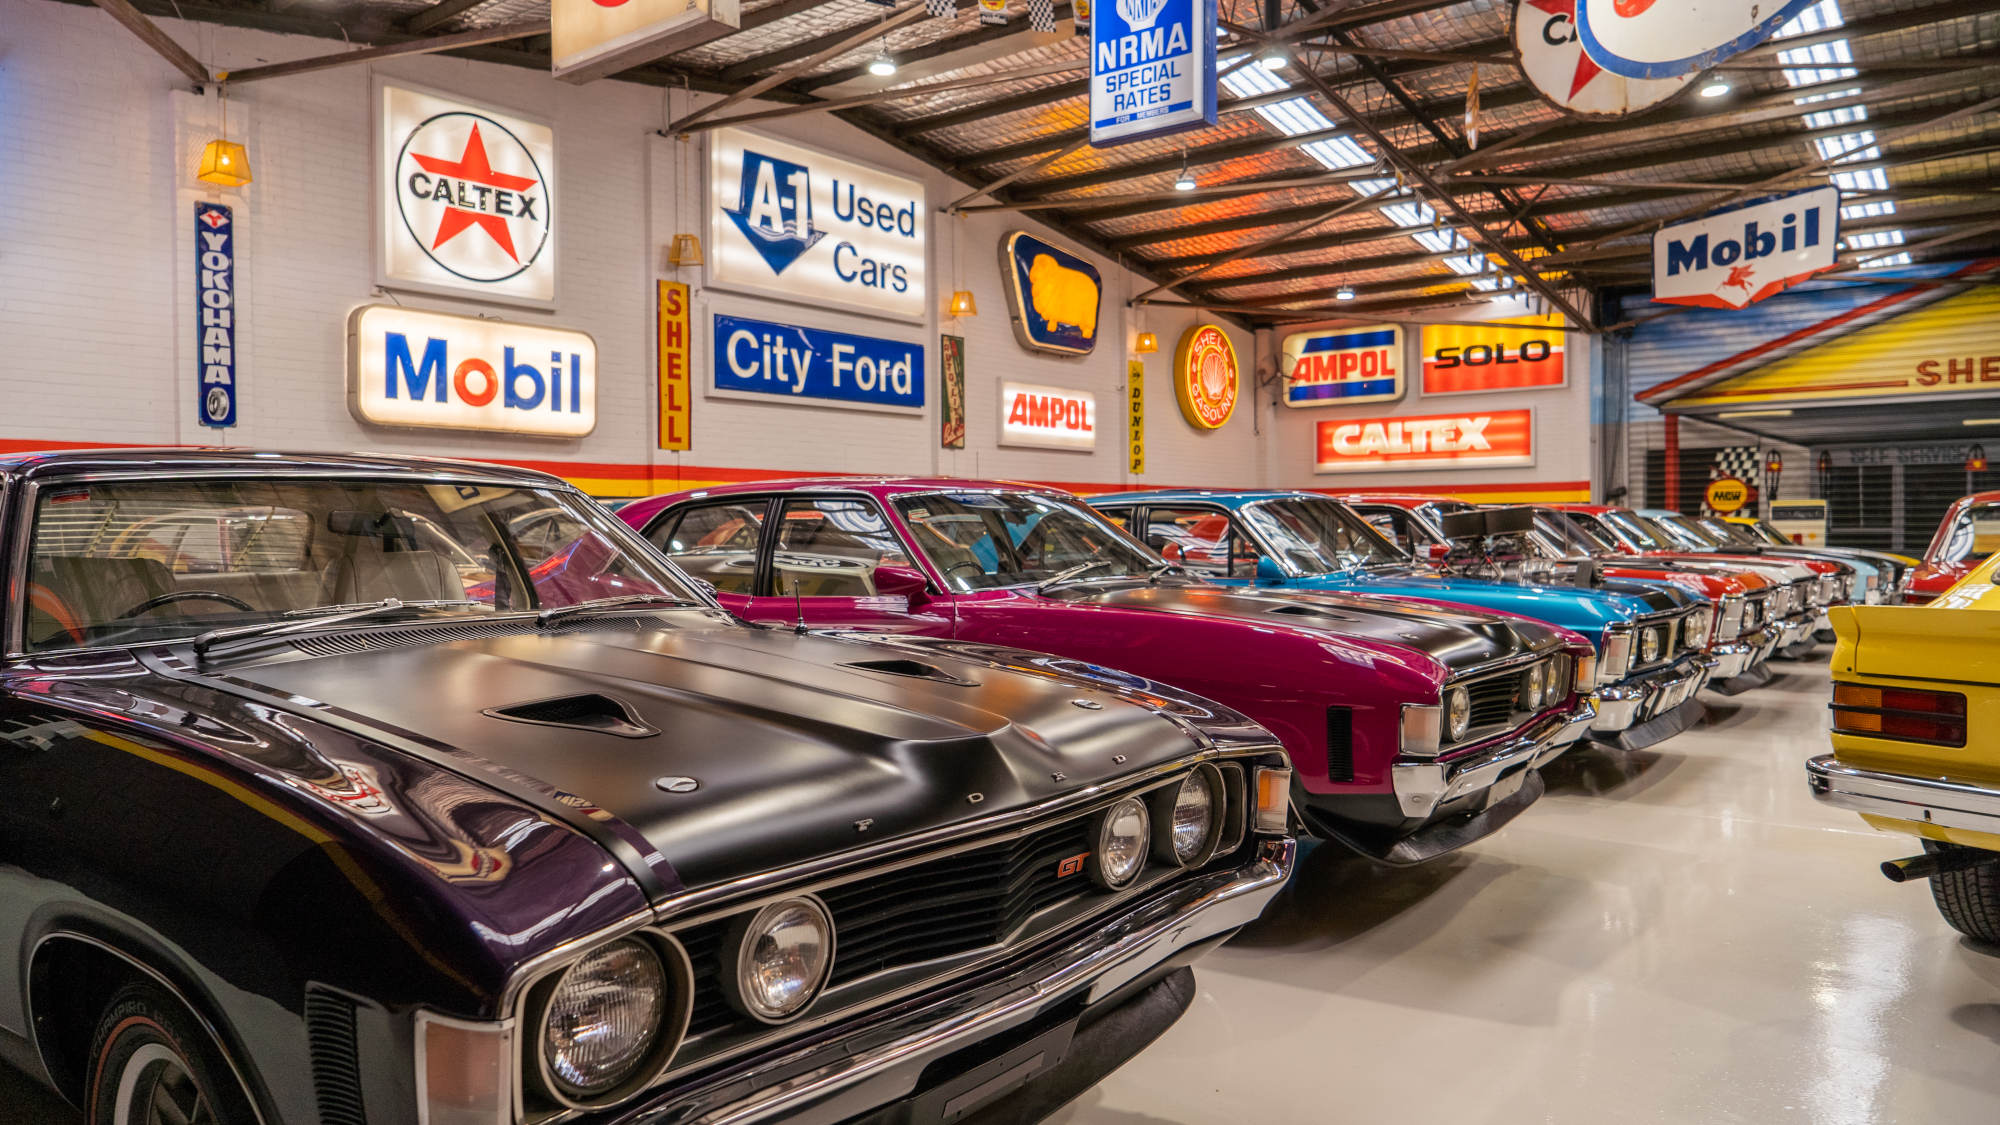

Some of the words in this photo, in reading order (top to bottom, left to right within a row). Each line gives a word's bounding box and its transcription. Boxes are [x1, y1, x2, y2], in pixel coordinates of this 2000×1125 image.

[1099, 22, 1188, 72] NRMA
[1106, 61, 1181, 93] SPECIAL
[1114, 83, 1171, 112] RATES
[1116, 115, 1130, 124] FOR
[1136, 107, 1169, 120] MEMBERS
[410, 172, 538, 221] CALTEX
[748, 160, 809, 239] A-1
[833, 179, 915, 238] Used
[1667, 206, 1820, 277] Mobil
[833, 242, 908, 293] Cars
[202, 232, 231, 384] YOKOHAMA
[385, 331, 581, 413] Mobil
[667, 288, 682, 444] SHELL
[726, 329, 812, 393] City
[832, 343, 912, 395] Ford
[1194, 333, 1229, 362] SHELL
[1289, 349, 1395, 383] AMPOL
[1434, 340, 1551, 369] SOLO
[1008, 393, 1093, 431] AMPOL
[1192, 383, 1234, 421] GASOLINE
[1131, 387, 1141, 470] DUNLOP
[1332, 417, 1491, 455] CALTEX
[1057, 852, 1091, 878] GT
